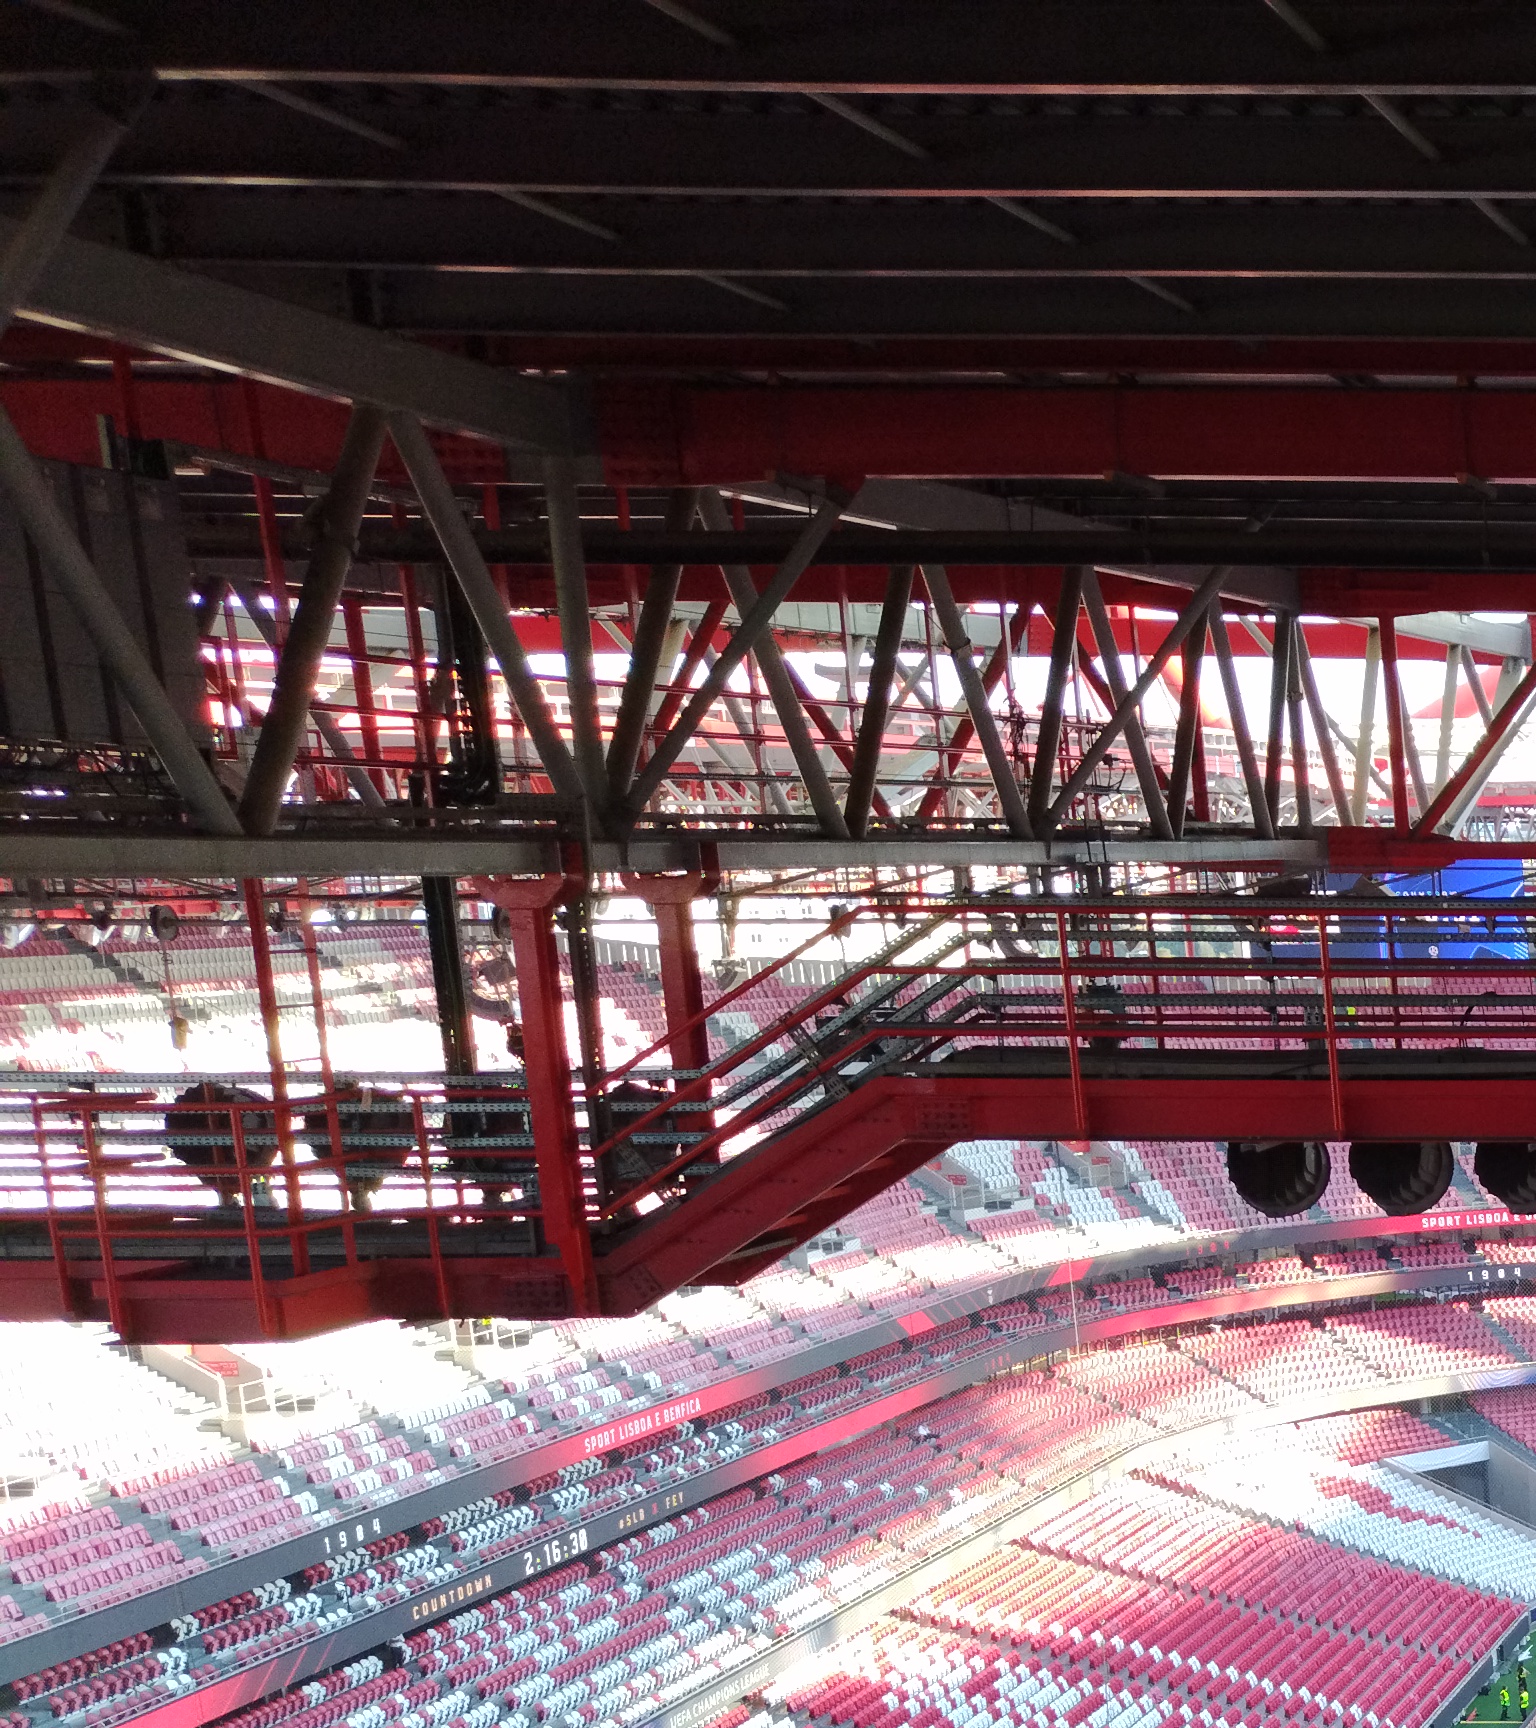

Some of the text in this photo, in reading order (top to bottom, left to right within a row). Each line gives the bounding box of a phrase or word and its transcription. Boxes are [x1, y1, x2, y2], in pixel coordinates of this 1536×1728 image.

[1421, 1215, 1461, 1229] SPORT
[1466, 1212, 1510, 1226] LISBOA
[584, 1397, 702, 1454] SPORT LISBOA E BENFICA
[412, 1573, 492, 1621] COUNTDOWN
[691, 1677, 740, 1721] CHAMPIONS
[740, 1663, 770, 1694] LEAGUE
